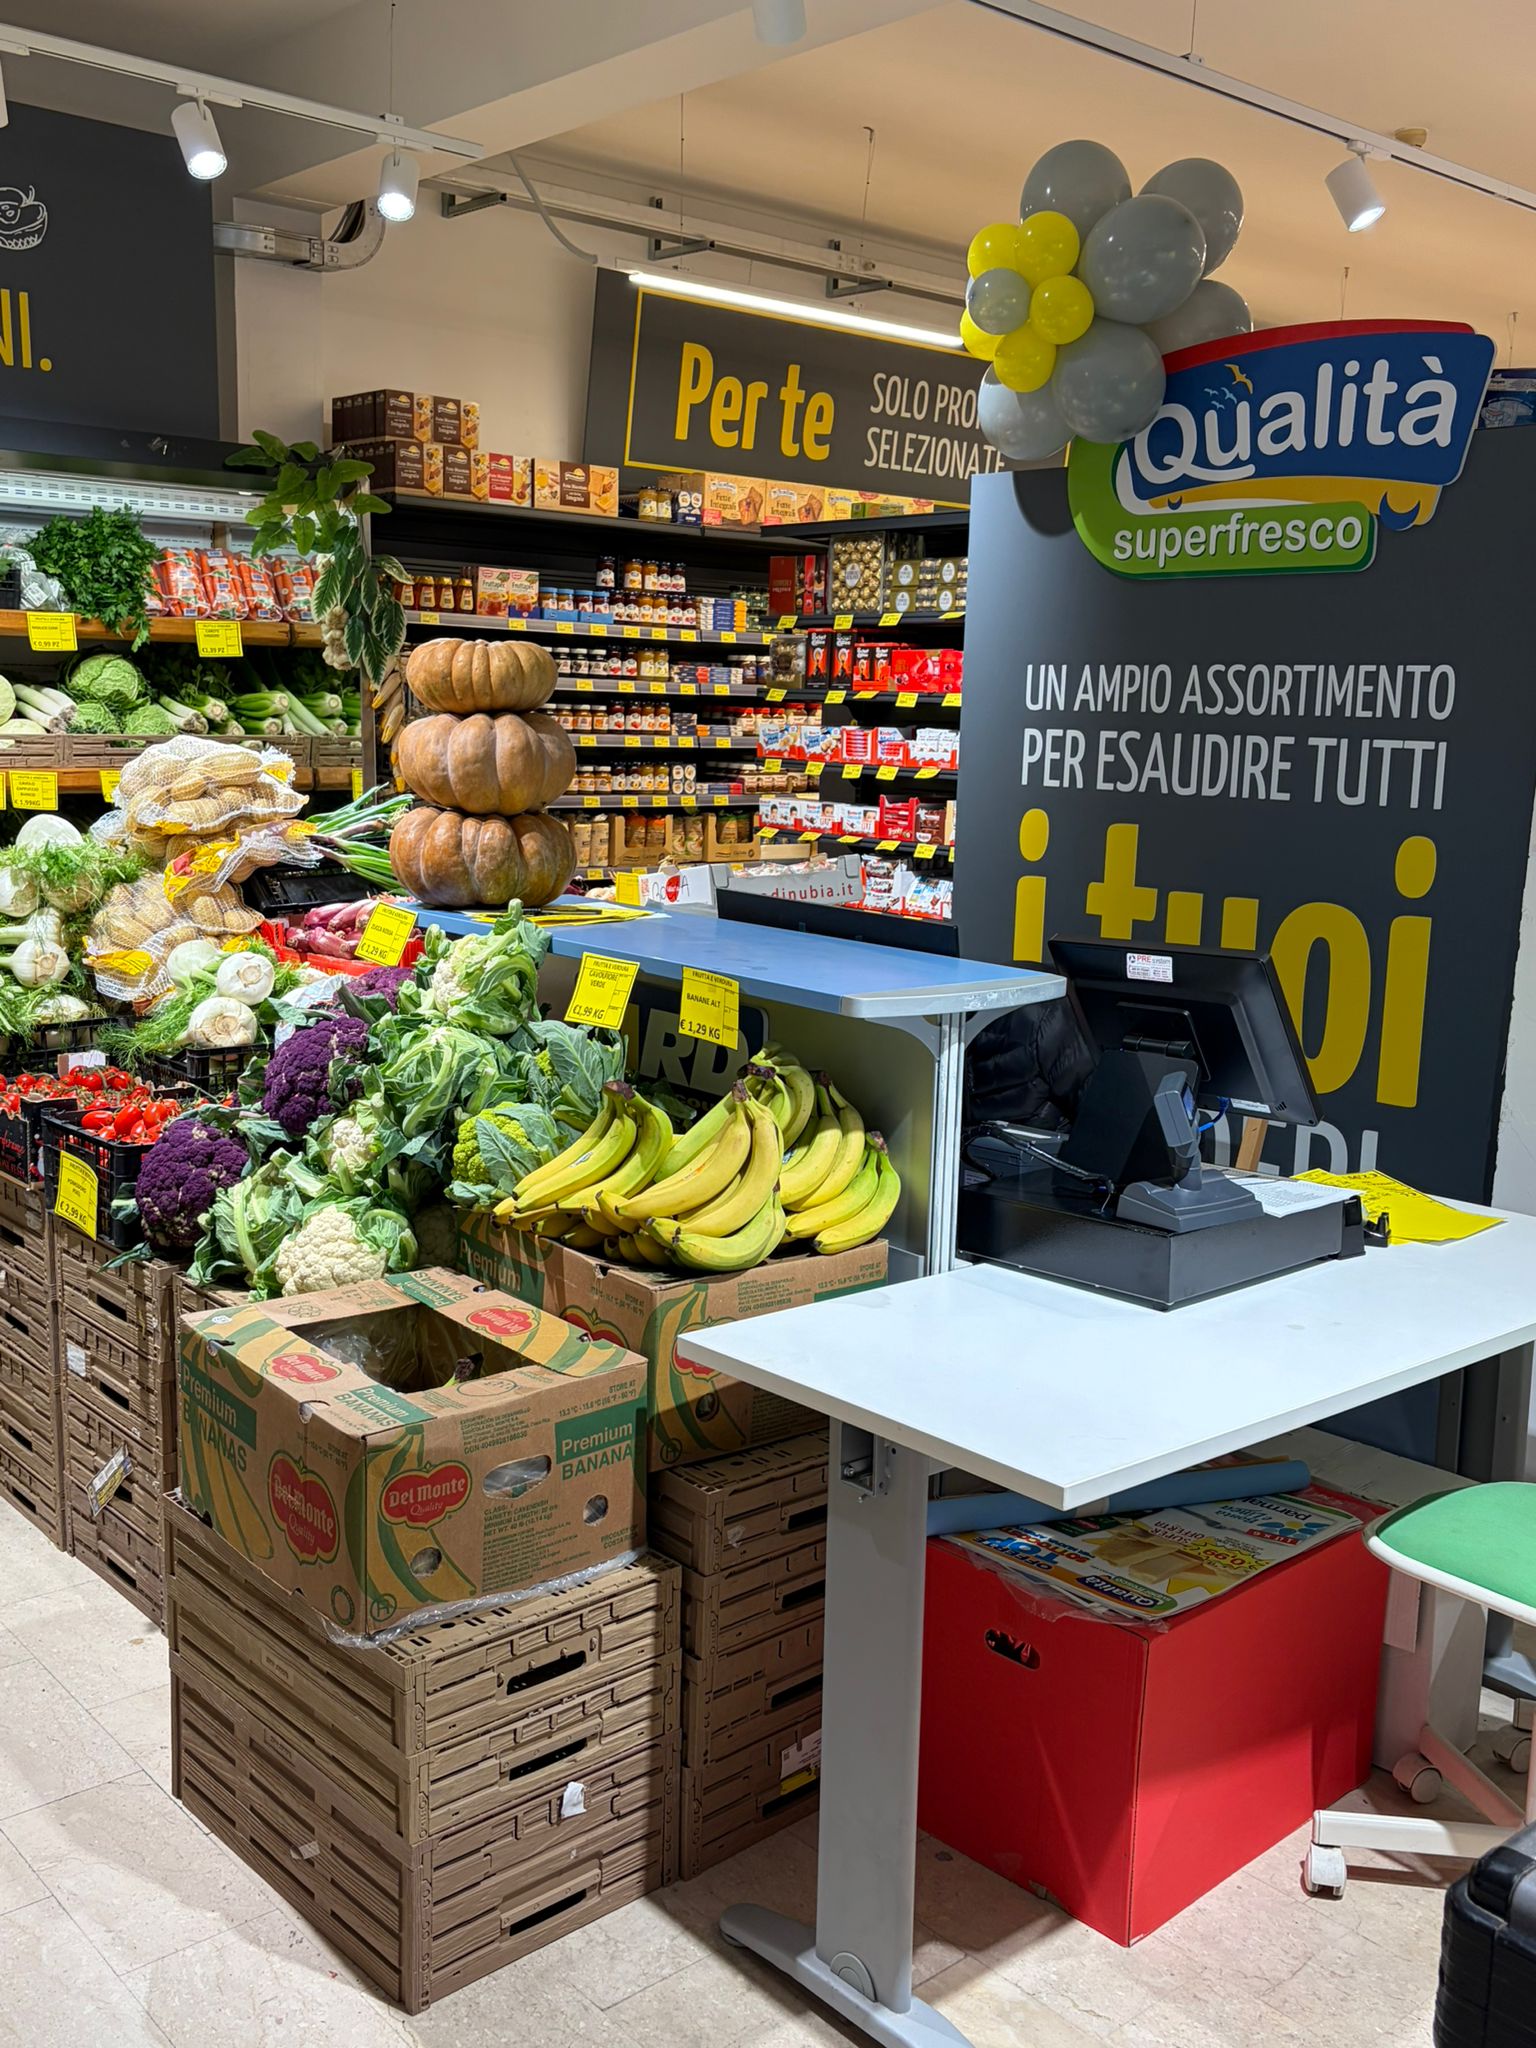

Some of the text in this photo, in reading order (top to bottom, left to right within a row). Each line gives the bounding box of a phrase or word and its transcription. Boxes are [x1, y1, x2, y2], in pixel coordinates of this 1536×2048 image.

[675, 342, 835, 460] Per te
[870, 373, 981, 429] SOLO PRO
[1134, 356, 1458, 484] Qualità
[1113, 513, 1363, 568] superfresco
[1025, 664, 1456, 720] UN AMPIO ASSORTIMENTO
[1020, 728, 1448, 810] PER ESAUDIRE TUTTI
[366, 944, 379, 956] 1,29
[379, 950, 388, 959] KG
[573, 1005, 605, 1020] €1,99 KG
[686, 992, 721, 1008] BANANE ALT
[680, 1019, 721, 1040] € 1,29 KG
[59, 1201, 87, 1225] € 2,99 KG
[461, 1239, 521, 1291] Premium
[284, 1355, 301, 1368] Del
[183, 1364, 237, 1429] Premium
[334, 1393, 397, 1427] BANANAS
[356, 1387, 409, 1418] Premium
[183, 1398, 247, 1473] BNANAS
[561, 1422, 633, 1456] Premium
[273, 1473, 292, 1501] Del
[389, 1476, 466, 1508] Del Monte
[410, 1501, 444, 1516] Quality
[1150, 1528, 1192, 1545] SUPER
[1202, 1548, 1247, 1567] 0,99
[1086, 1576, 1163, 1607] Qualità
